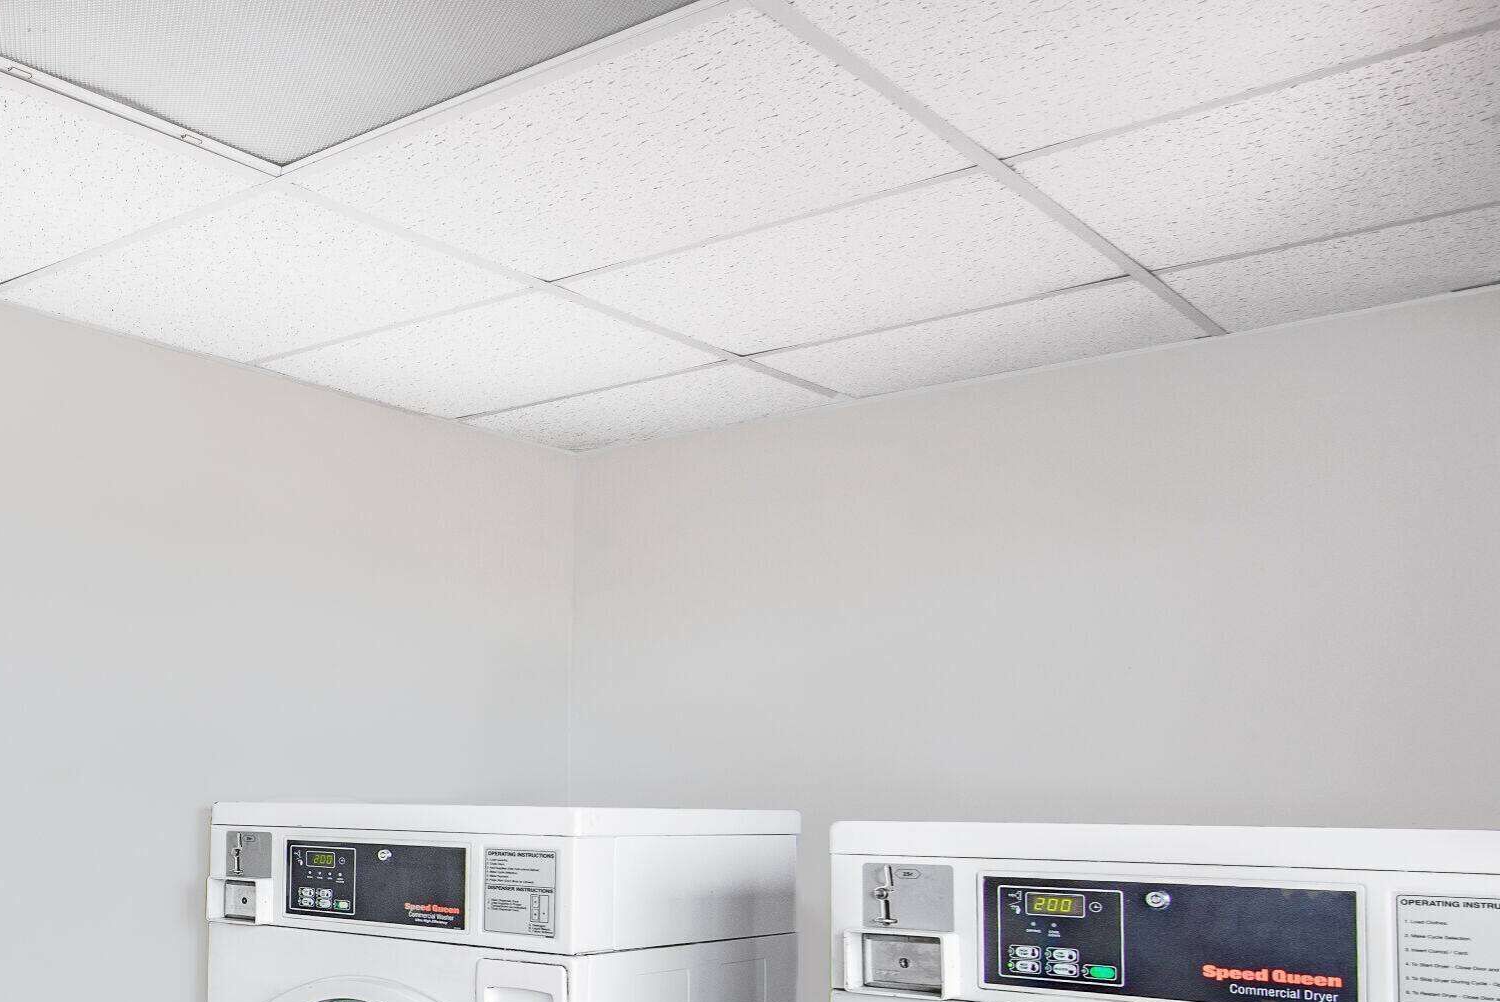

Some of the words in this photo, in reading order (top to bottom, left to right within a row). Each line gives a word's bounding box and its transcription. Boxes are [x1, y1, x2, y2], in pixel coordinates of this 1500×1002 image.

[1034, 898, 1072, 912] 200
[1400, 899, 1460, 908] OPERATING
[1202, 964, 1268, 981] Speed
[1272, 970, 1343, 987] Queen
[1229, 984, 1300, 999] Commercial
[1304, 990, 1338, 1002] Dryer
